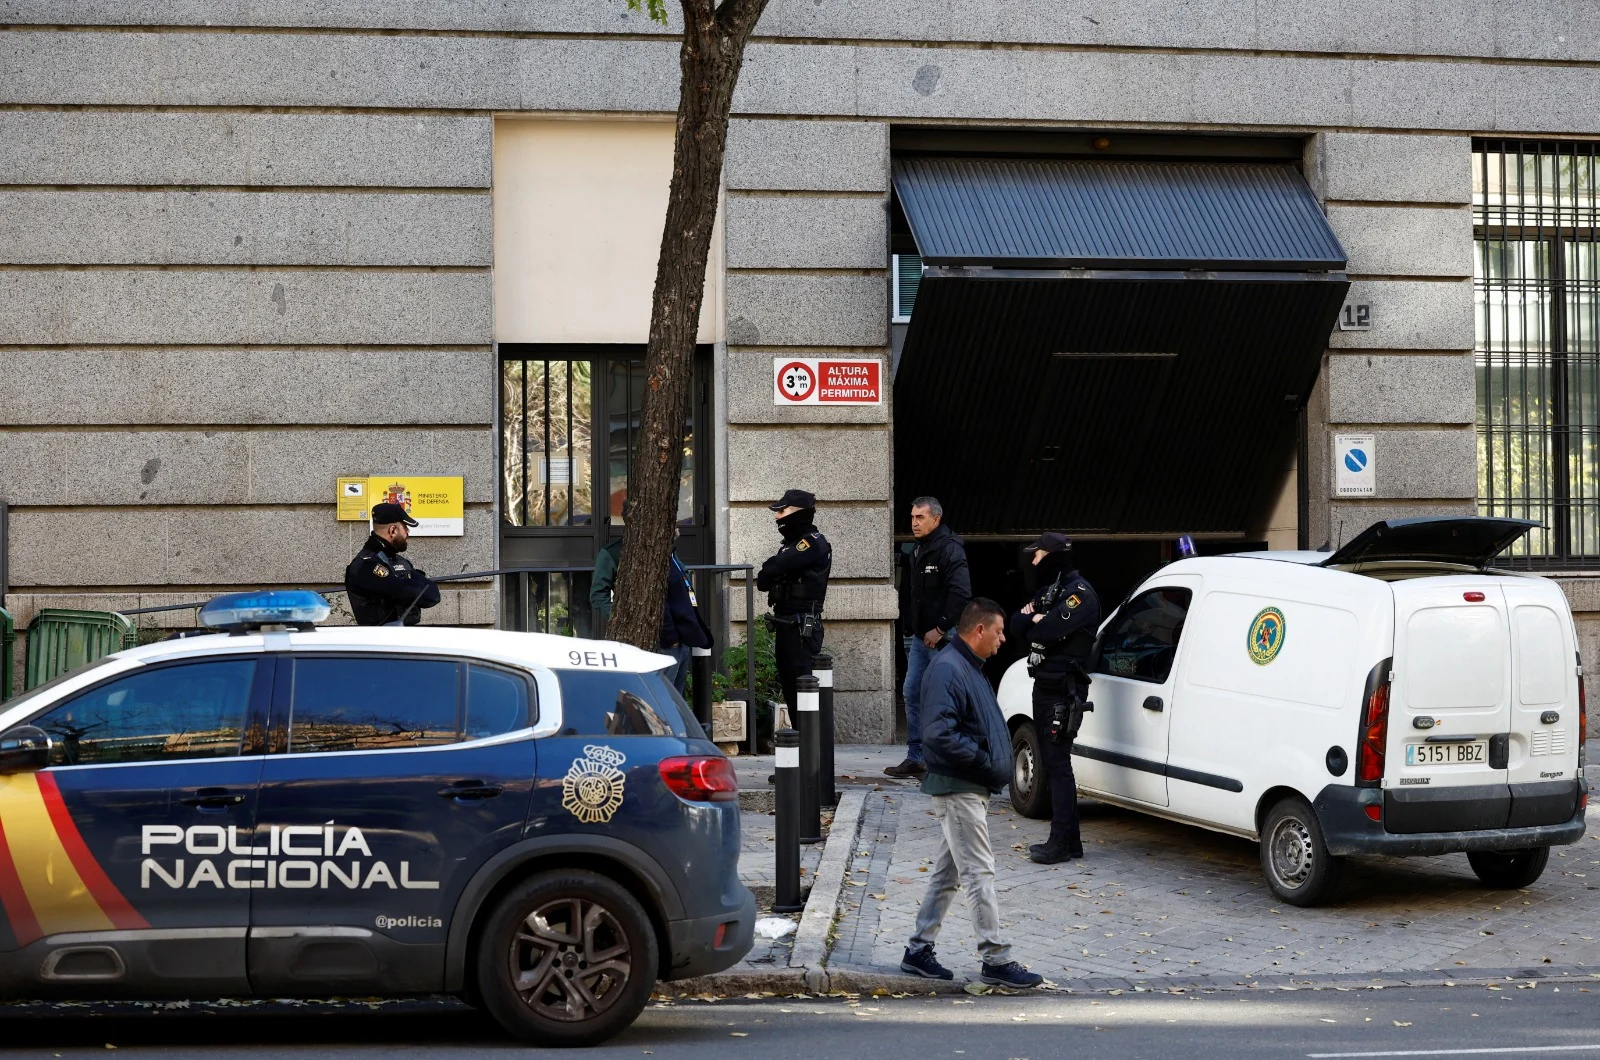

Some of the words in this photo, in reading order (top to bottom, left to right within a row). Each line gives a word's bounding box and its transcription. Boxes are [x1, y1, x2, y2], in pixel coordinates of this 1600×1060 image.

[1343, 304, 1370, 327] 12
[828, 366, 869, 375] ALTURA
[828, 374, 869, 386] MÁXIMA
[821, 389, 877, 398] PERMITIDA
[568, 650, 618, 668] 9EH
[1417, 745, 1451, 762] 5151
[1457, 745, 1482, 761] BBZ
[142, 820, 373, 856] POLICÍA
[141, 858, 440, 889] NACIONAL
[375, 915, 443, 930] @policia
